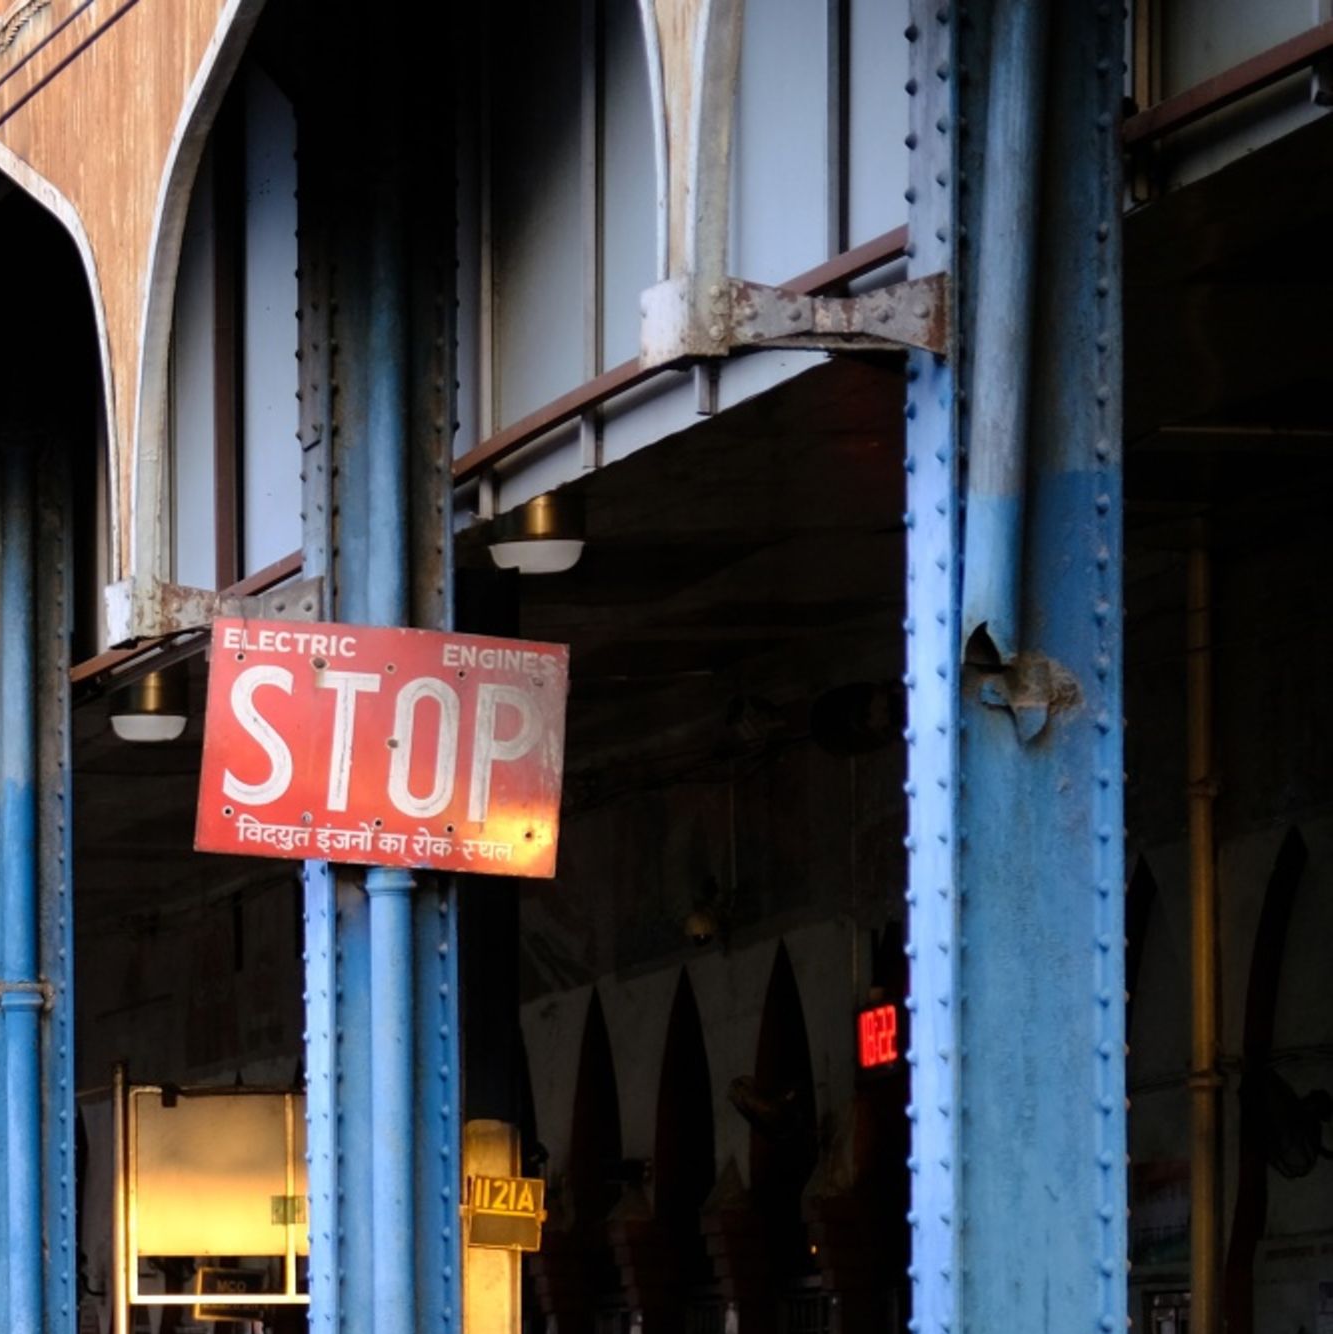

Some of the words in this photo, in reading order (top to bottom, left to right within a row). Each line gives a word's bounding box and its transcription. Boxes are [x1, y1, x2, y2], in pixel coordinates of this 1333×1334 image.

[223, 627, 357, 658] ELECTRIC
[442, 644, 558, 674] ENGINES
[221, 664, 543, 823] STOP
[315, 822, 374, 853] इंजनों
[378, 831, 409, 855] का
